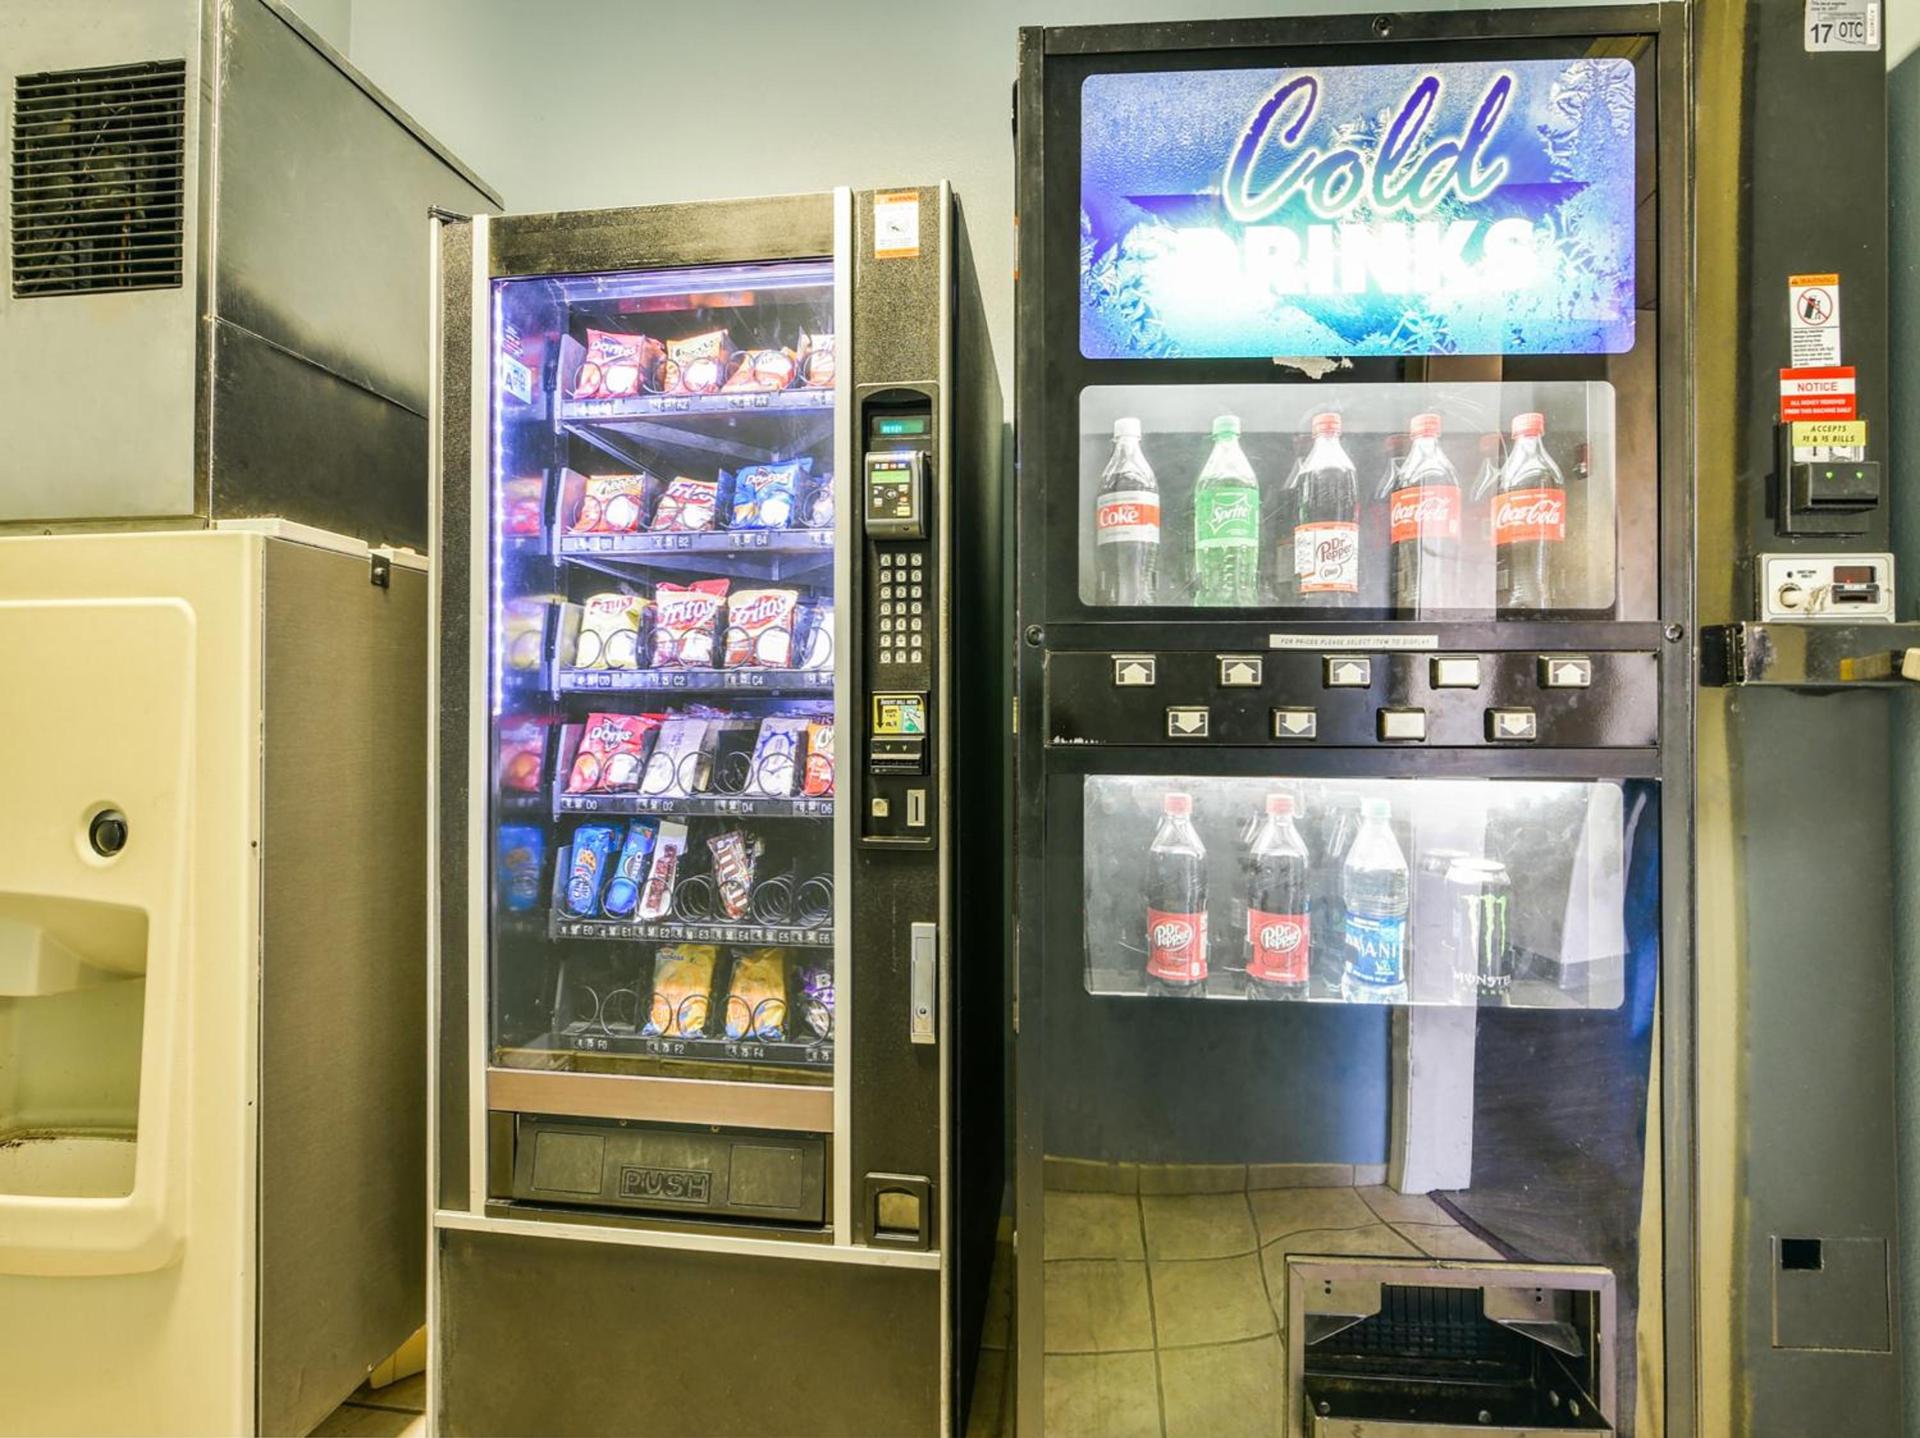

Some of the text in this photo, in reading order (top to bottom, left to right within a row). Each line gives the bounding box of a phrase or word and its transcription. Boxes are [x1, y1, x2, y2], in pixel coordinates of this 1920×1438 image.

[1810, 23, 1833, 44] 17
[1839, 21, 1863, 38] OTC
[1224, 73, 1512, 220] Cold
[1172, 219, 1537, 297] DRINKS
[1797, 382, 1838, 392] NOTICE
[1811, 425, 1847, 433] ACCEPTS
[1832, 434, 1855, 442] BILLS
[1100, 507, 1139, 526] Coke
[1211, 505, 1250, 523] Sprite
[1392, 498, 1450, 527] Coca-Cola
[1497, 500, 1561, 529] Coca-Cola
[1316, 541, 1353, 562] Pepper
[1331, 537, 1346, 550] Dr
[1453, 973, 1512, 988] MONSTE
[624, 1171, 706, 1198] PUSH
